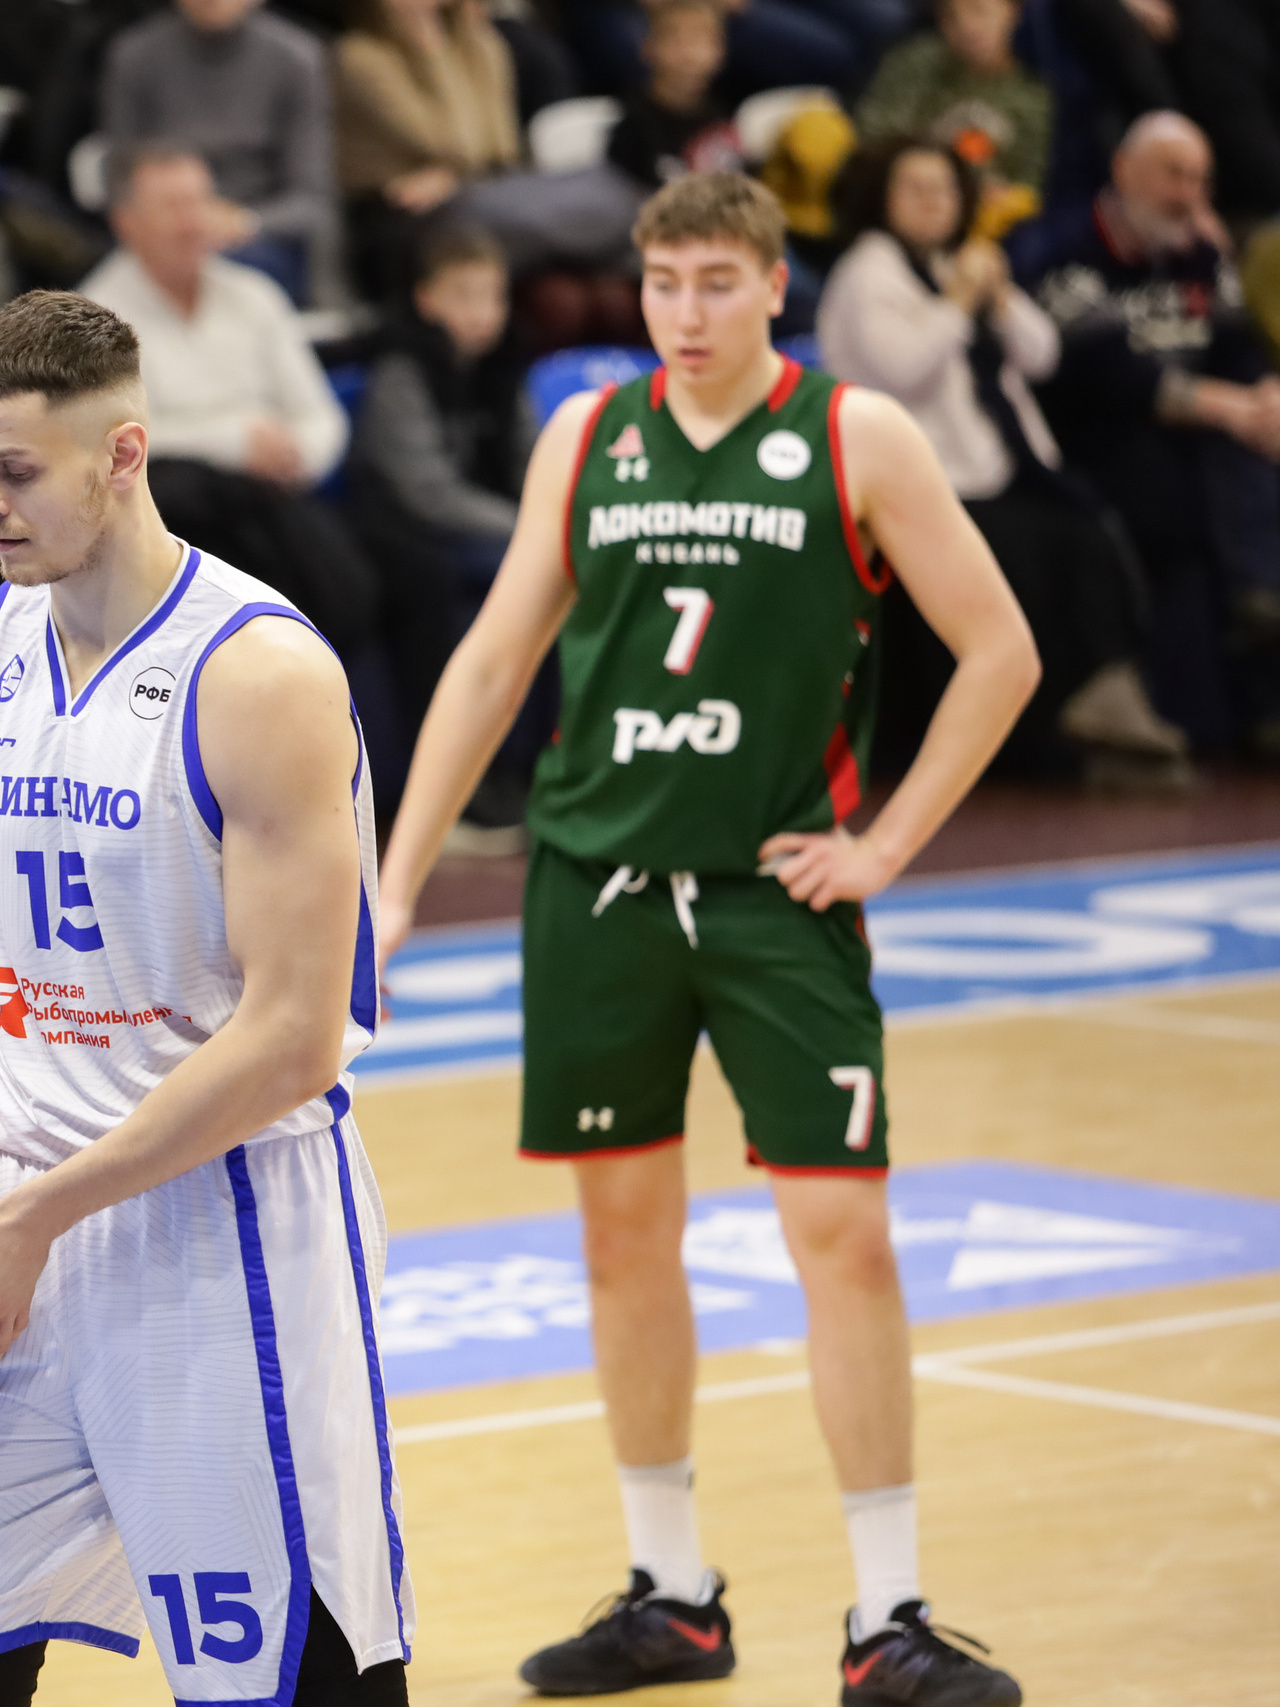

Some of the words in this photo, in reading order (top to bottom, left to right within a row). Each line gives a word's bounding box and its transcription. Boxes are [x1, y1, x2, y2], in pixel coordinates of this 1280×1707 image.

[588, 501, 807, 552] ЛОКОМОТИВ
[635, 541, 740, 566] КУБАНЬ
[663, 586, 714, 676] 7
[134, 684, 172, 703] РФБ
[15, 850, 105, 953] 15
[21, 978, 86, 1001] Русская
[827, 1065, 877, 1151] 7
[147, 1571, 264, 1665] 15
